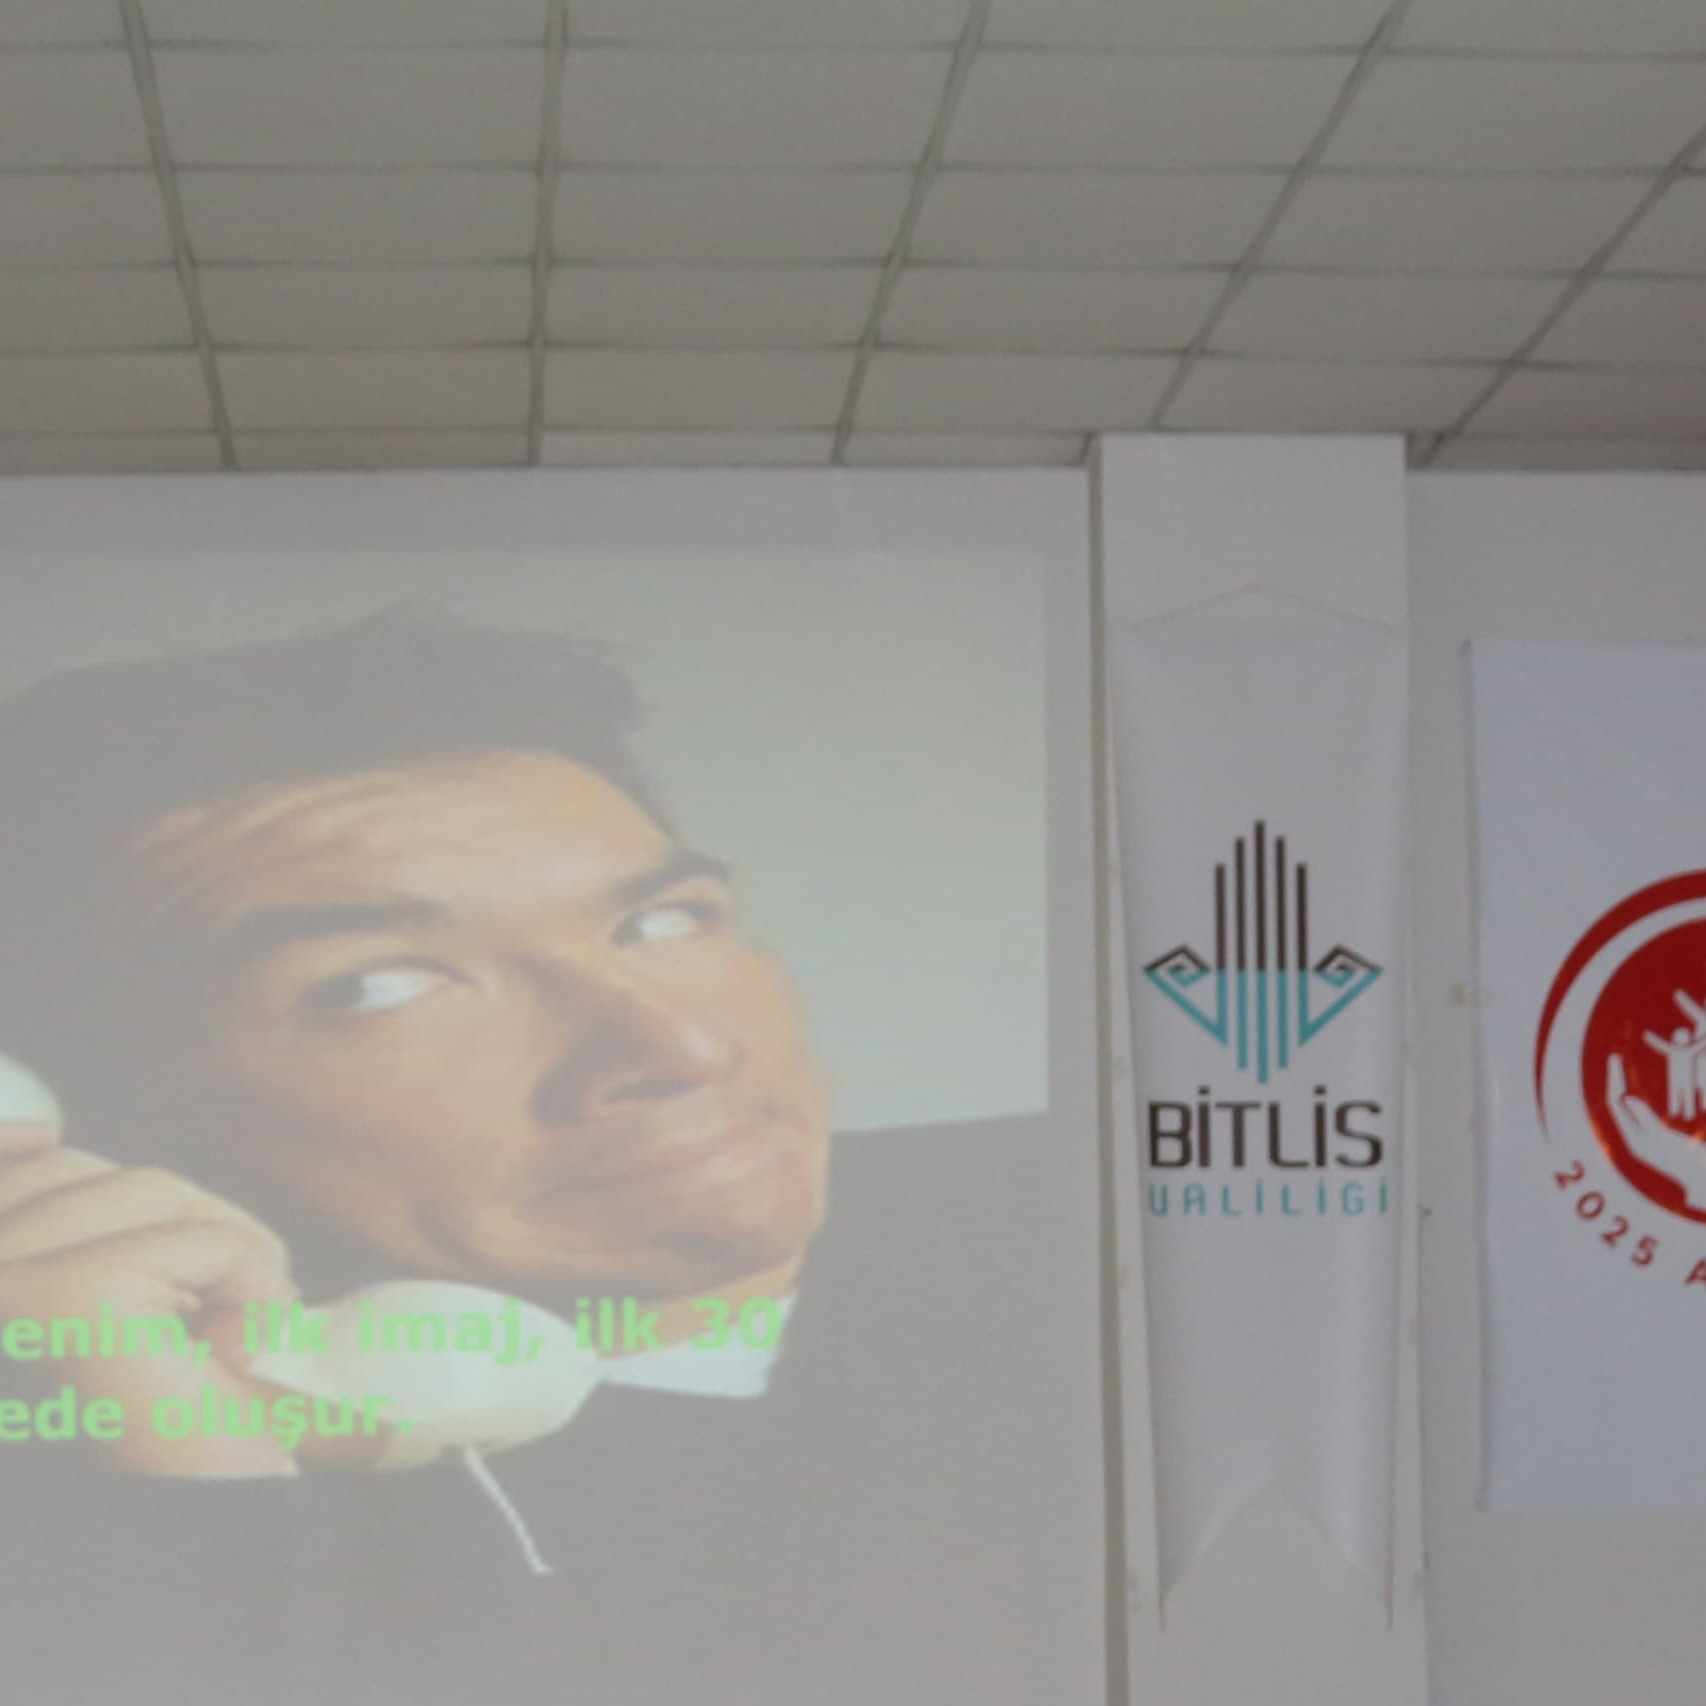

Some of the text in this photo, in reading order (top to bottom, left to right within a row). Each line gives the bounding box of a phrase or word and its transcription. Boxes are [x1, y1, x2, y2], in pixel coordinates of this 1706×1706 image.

[1148, 1085, 1384, 1170] BİTLİS
[1553, 1160, 1659, 1268] 2025
[242, 1299, 330, 1356] ilk
[358, 1297, 545, 1365] imaj,
[574, 1297, 663, 1352] ilk
[690, 1297, 783, 1351] 30
[150, 1384, 415, 1450] oluşur.
